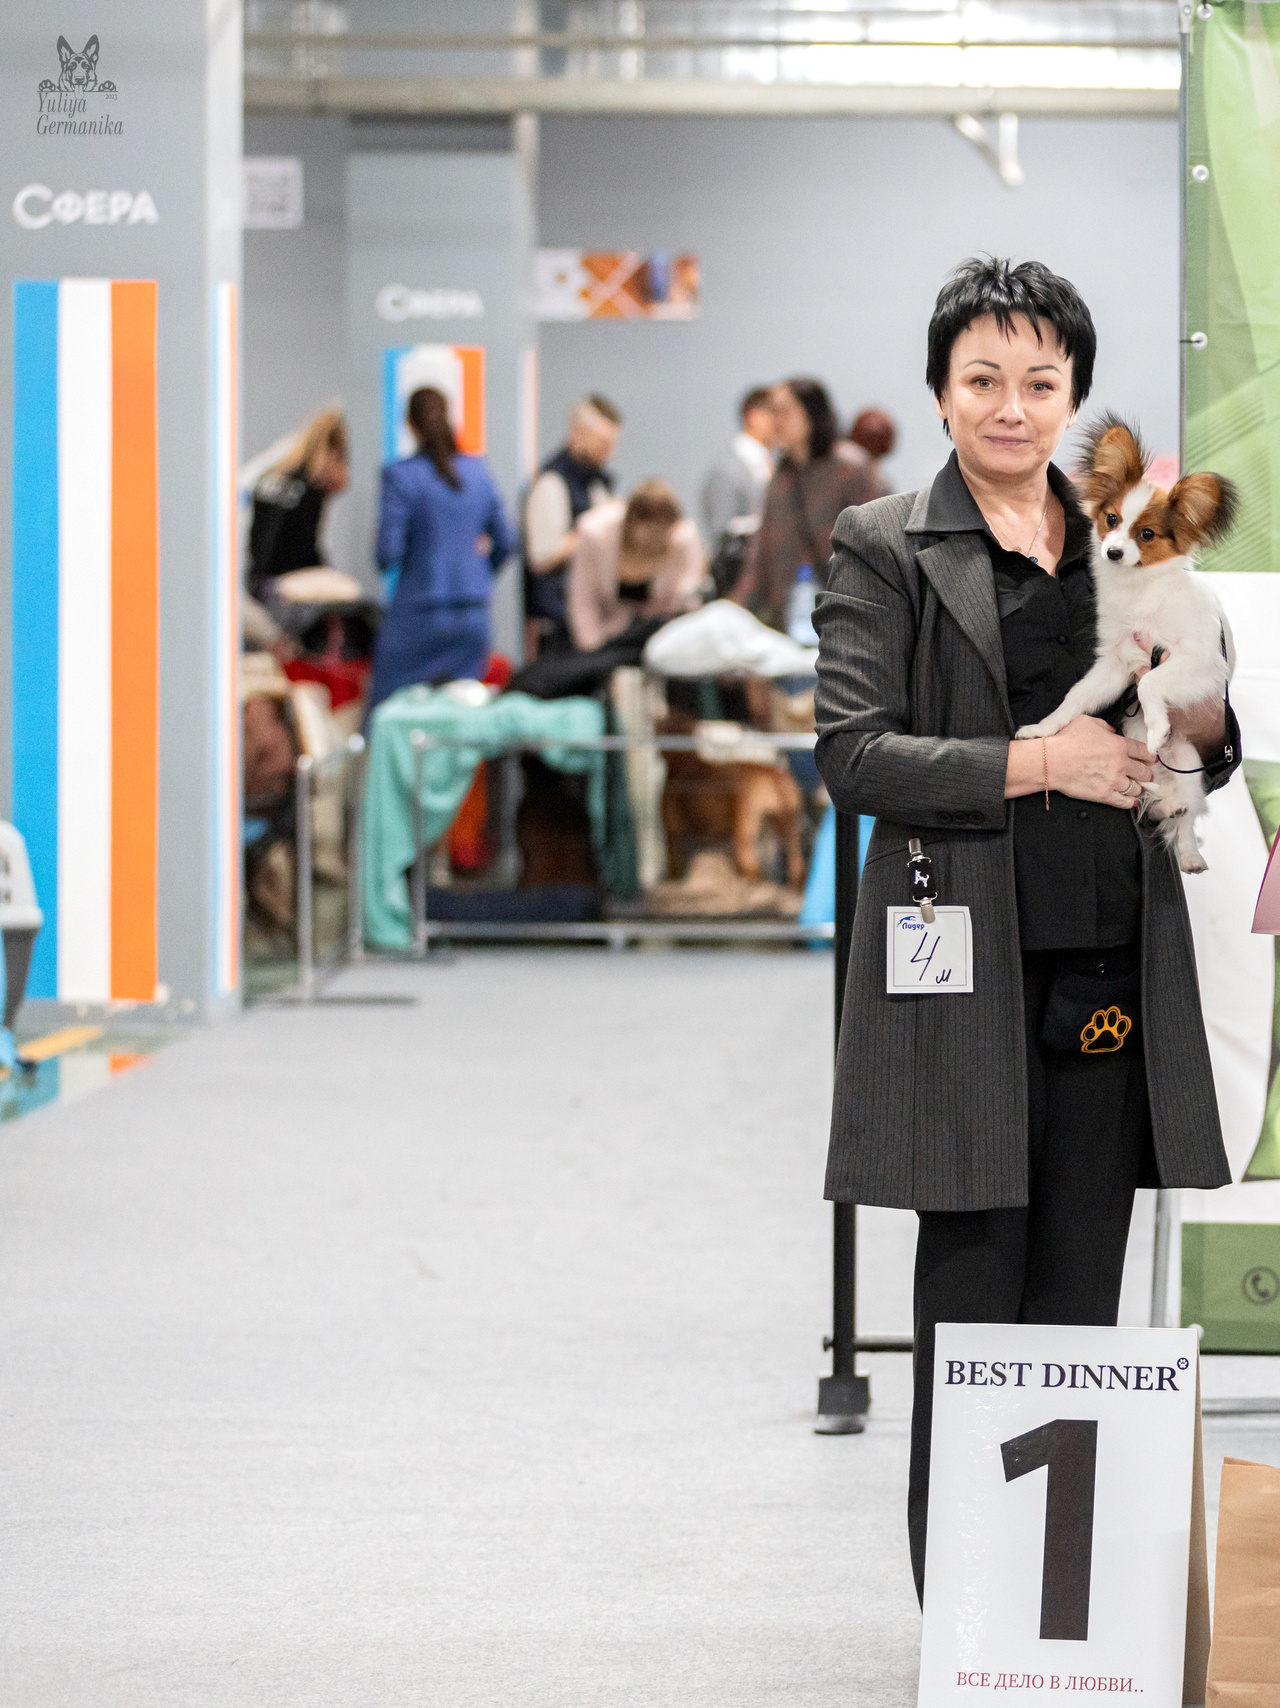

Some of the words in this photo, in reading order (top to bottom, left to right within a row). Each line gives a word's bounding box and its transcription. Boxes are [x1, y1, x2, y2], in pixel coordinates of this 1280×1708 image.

[12, 183, 160, 230] СФЕРА
[902, 922, 925, 930] Лидер
[909, 931, 941, 982] 4
[945, 1360, 1033, 1388] BEST
[1040, 1362, 1180, 1392] DINNER
[1000, 1419, 1098, 1641] 1
[956, 1671, 991, 1688] ВСЕ
[993, 1673, 1045, 1691] ДЕЛО
[1049, 1674, 1061, 1689] В
[1064, 1675, 1145, 1693] ЛЮБВИ..
